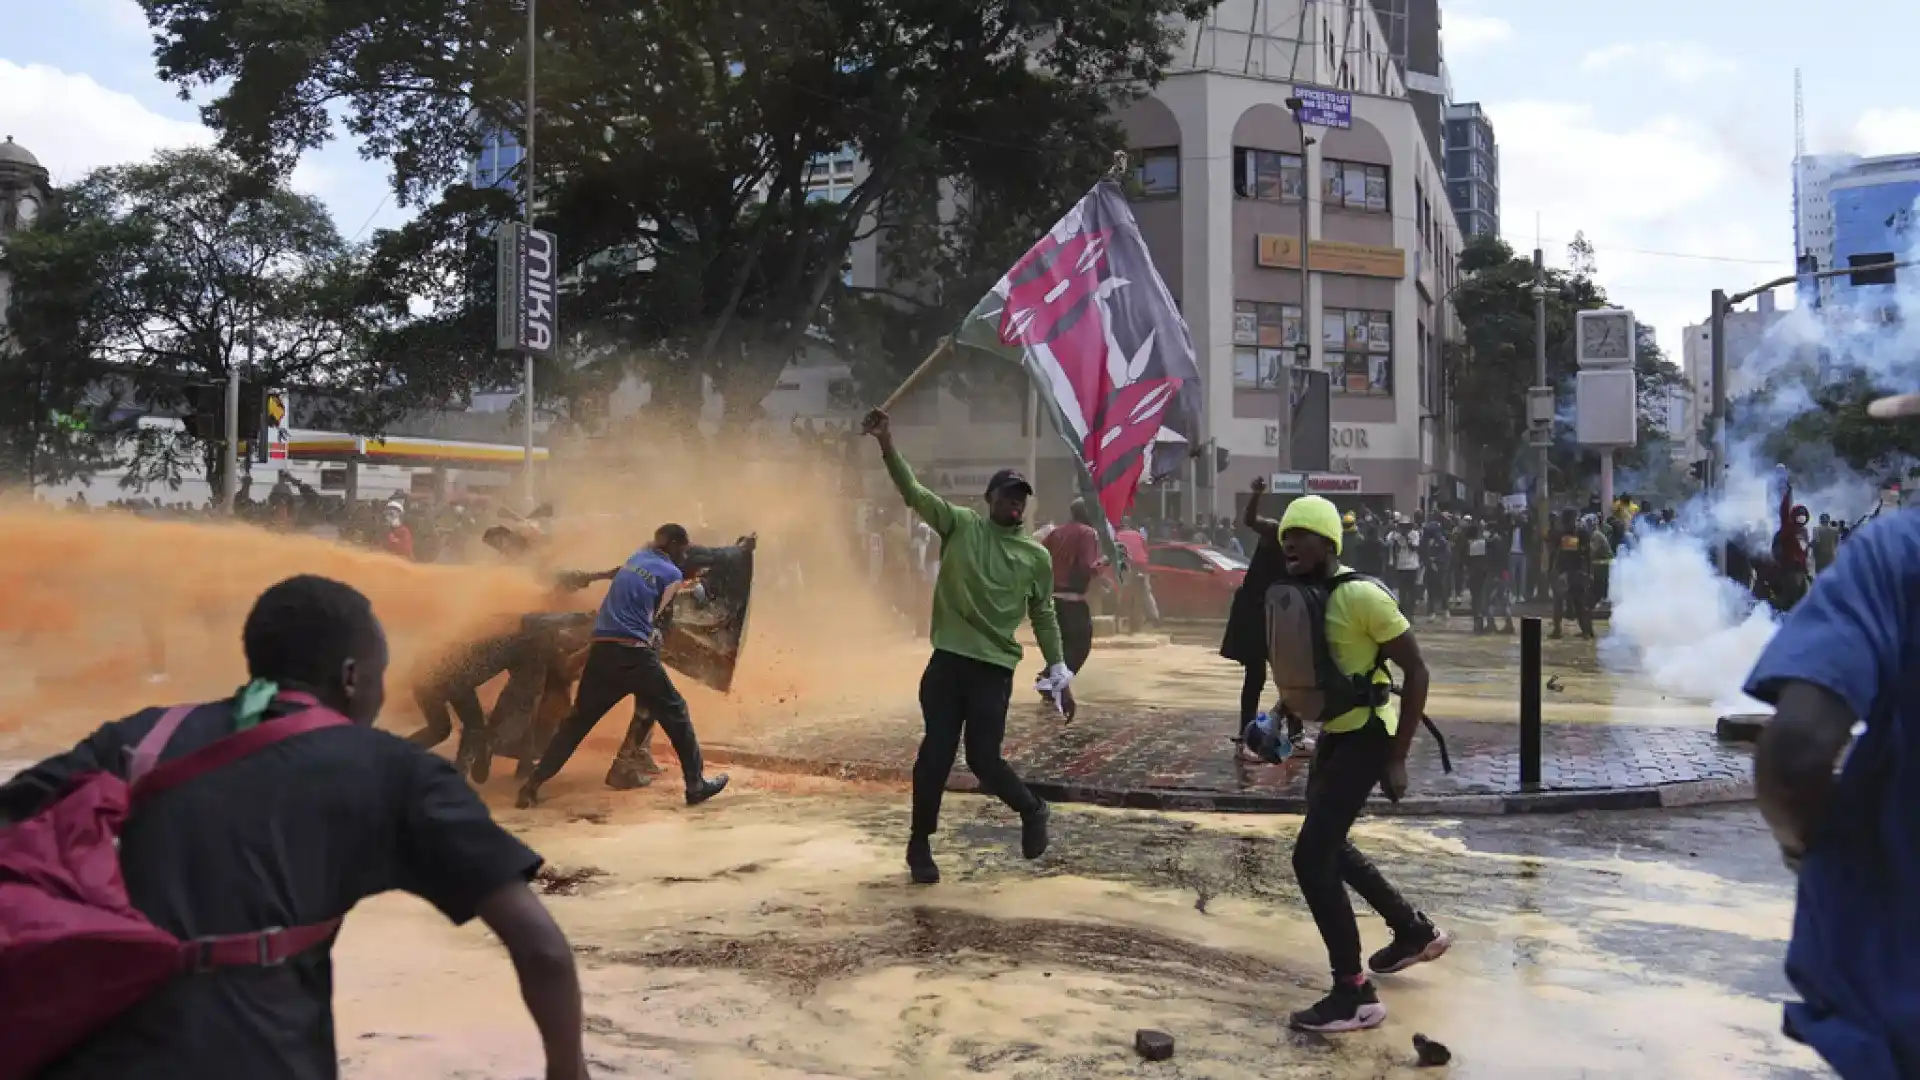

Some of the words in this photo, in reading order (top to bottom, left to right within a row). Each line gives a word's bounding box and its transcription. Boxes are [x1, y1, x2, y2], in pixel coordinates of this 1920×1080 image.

[1295, 88, 1324, 100] OFFICES
[1325, 93, 1336, 102] TO
[1337, 95, 1349, 104] LET
[528, 230, 552, 350] MIKA
